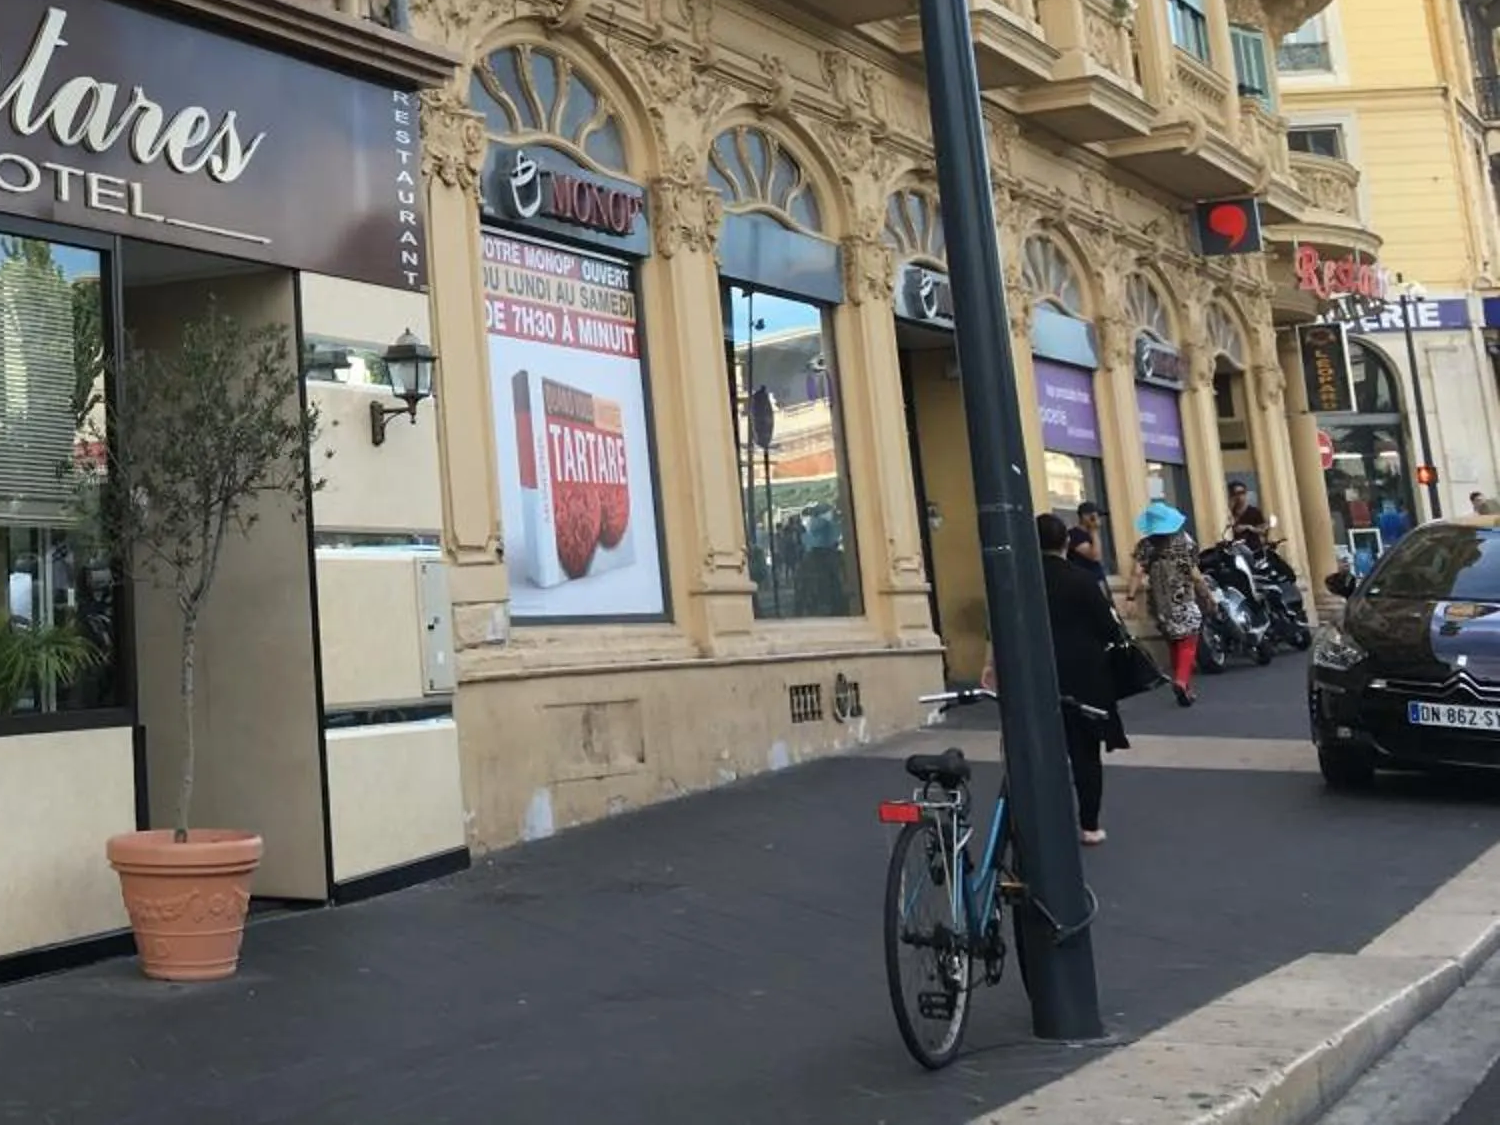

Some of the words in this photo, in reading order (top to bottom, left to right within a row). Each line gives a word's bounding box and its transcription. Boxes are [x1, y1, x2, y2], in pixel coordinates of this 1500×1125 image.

[393, 90, 418, 285] RESTAURANT
[484, 236, 521, 266] OTRE
[580, 258, 629, 289] OUVERT
[505, 269, 551, 301] LUNDI
[556, 280, 575, 306] AU
[580, 285, 635, 317] SAMEDI
[511, 303, 555, 341] 7H30
[562, 308, 575, 342] À
[578, 317, 636, 353] MINUIT
[549, 424, 627, 485] TARTARE
